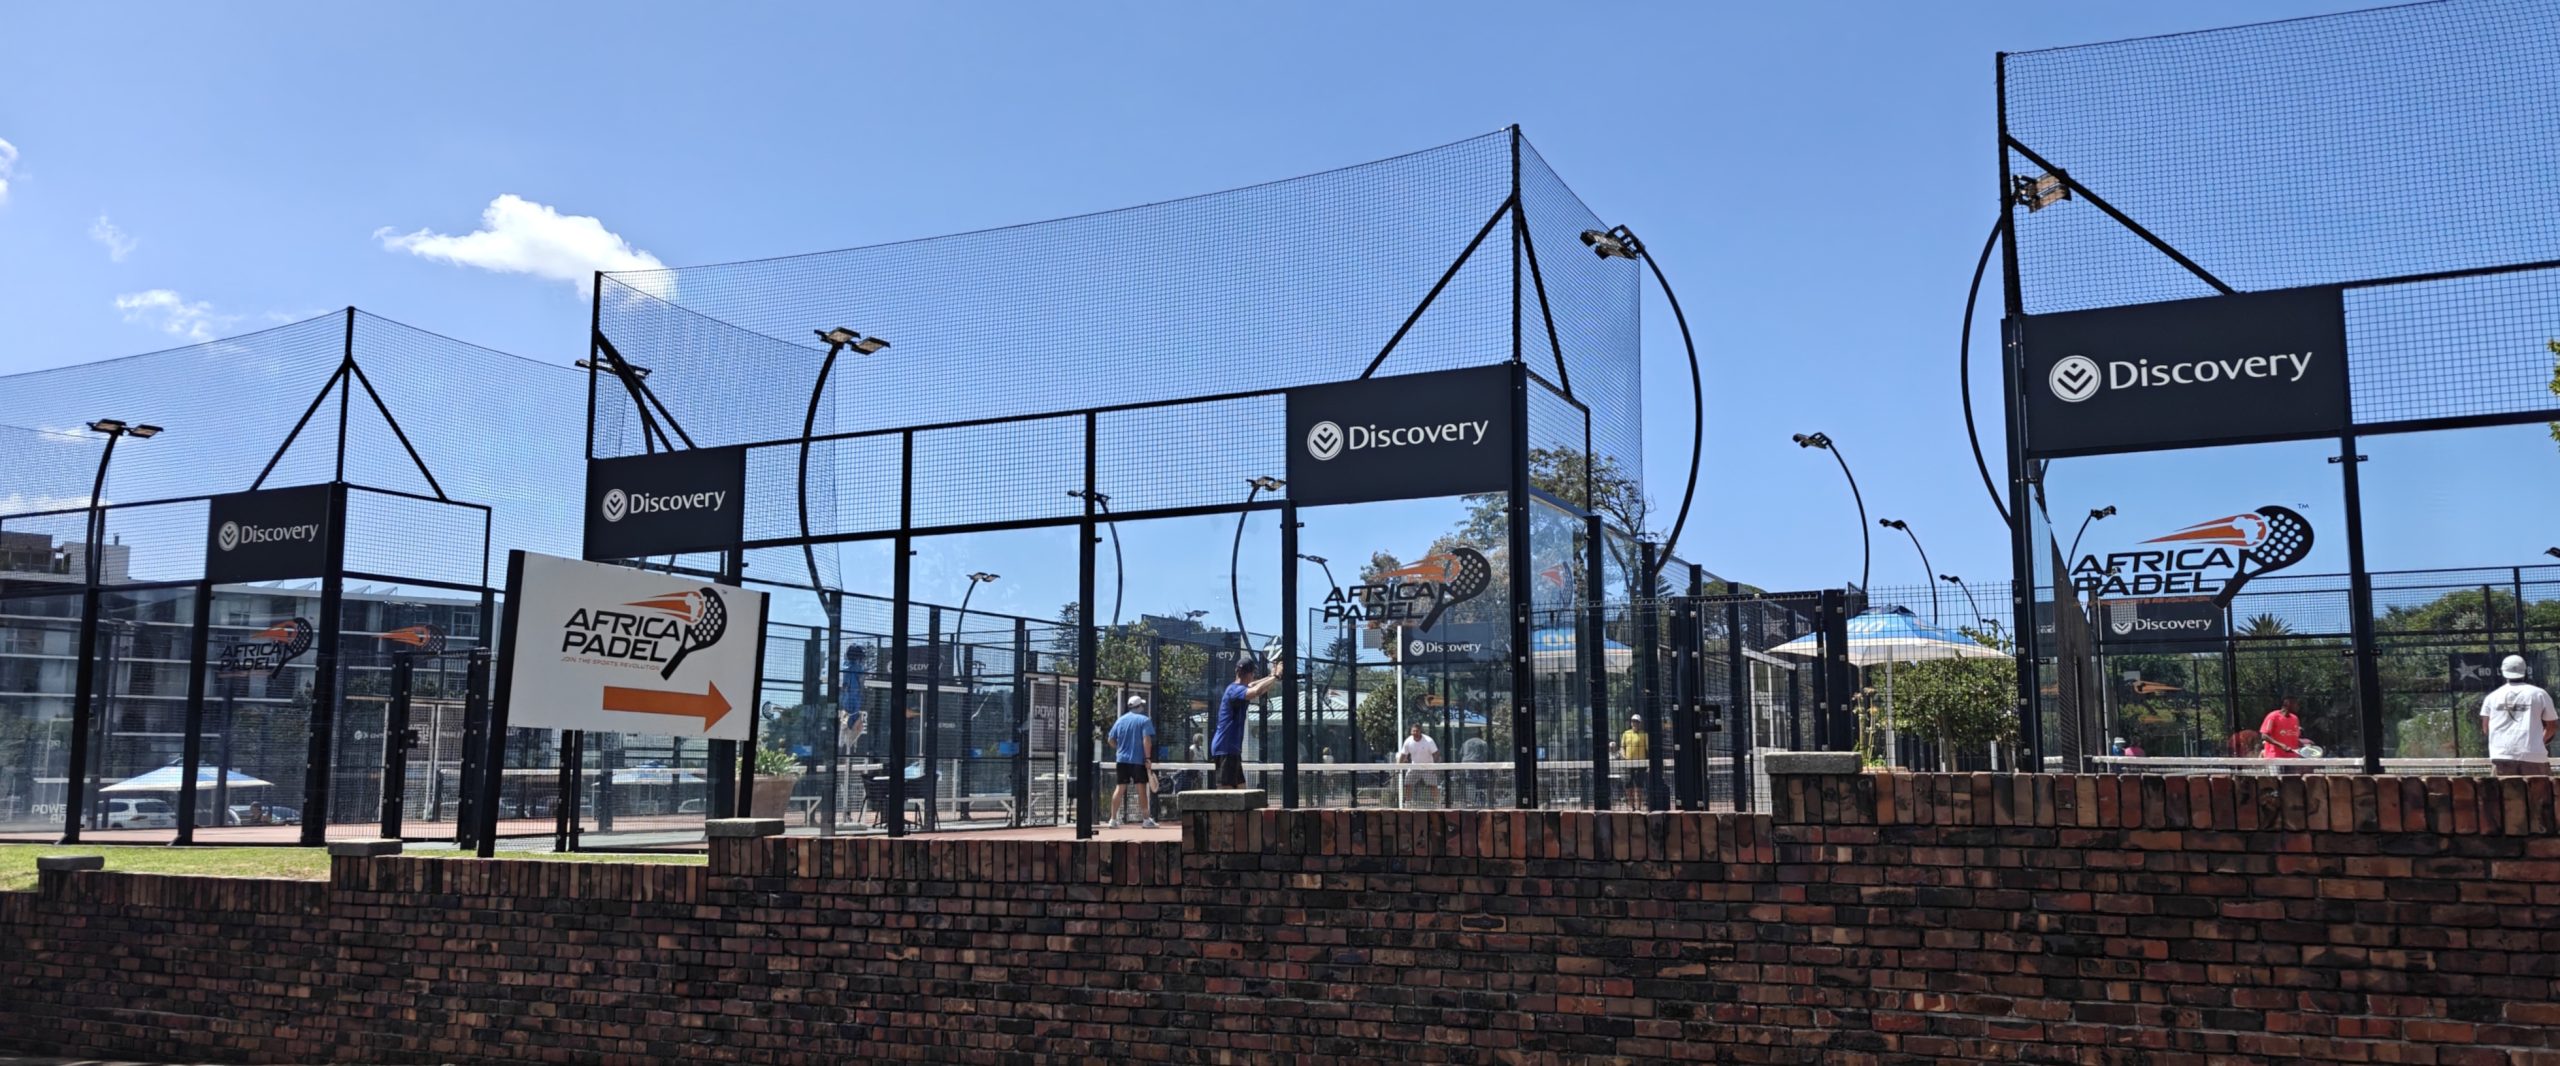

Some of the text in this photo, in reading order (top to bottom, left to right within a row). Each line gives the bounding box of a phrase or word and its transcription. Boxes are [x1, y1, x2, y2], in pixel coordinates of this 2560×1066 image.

[2109, 352, 2313, 390] Discovery
[1349, 420, 1489, 450] Discovery
[630, 490, 726, 514] Discovery
[241, 523, 319, 544] Discovery
[2071, 548, 2235, 577] AFRICA
[1323, 582, 1436, 604] AFRICA
[2072, 572, 2220, 598] PADEL
[1323, 601, 1424, 623] PADEL
[564, 608, 681, 642] AFRICA
[2135, 618, 2212, 631] Discovery
[220, 642, 283, 658] AFRICA
[562, 631, 668, 662] PADEL
[219, 657, 279, 672] PADEL
